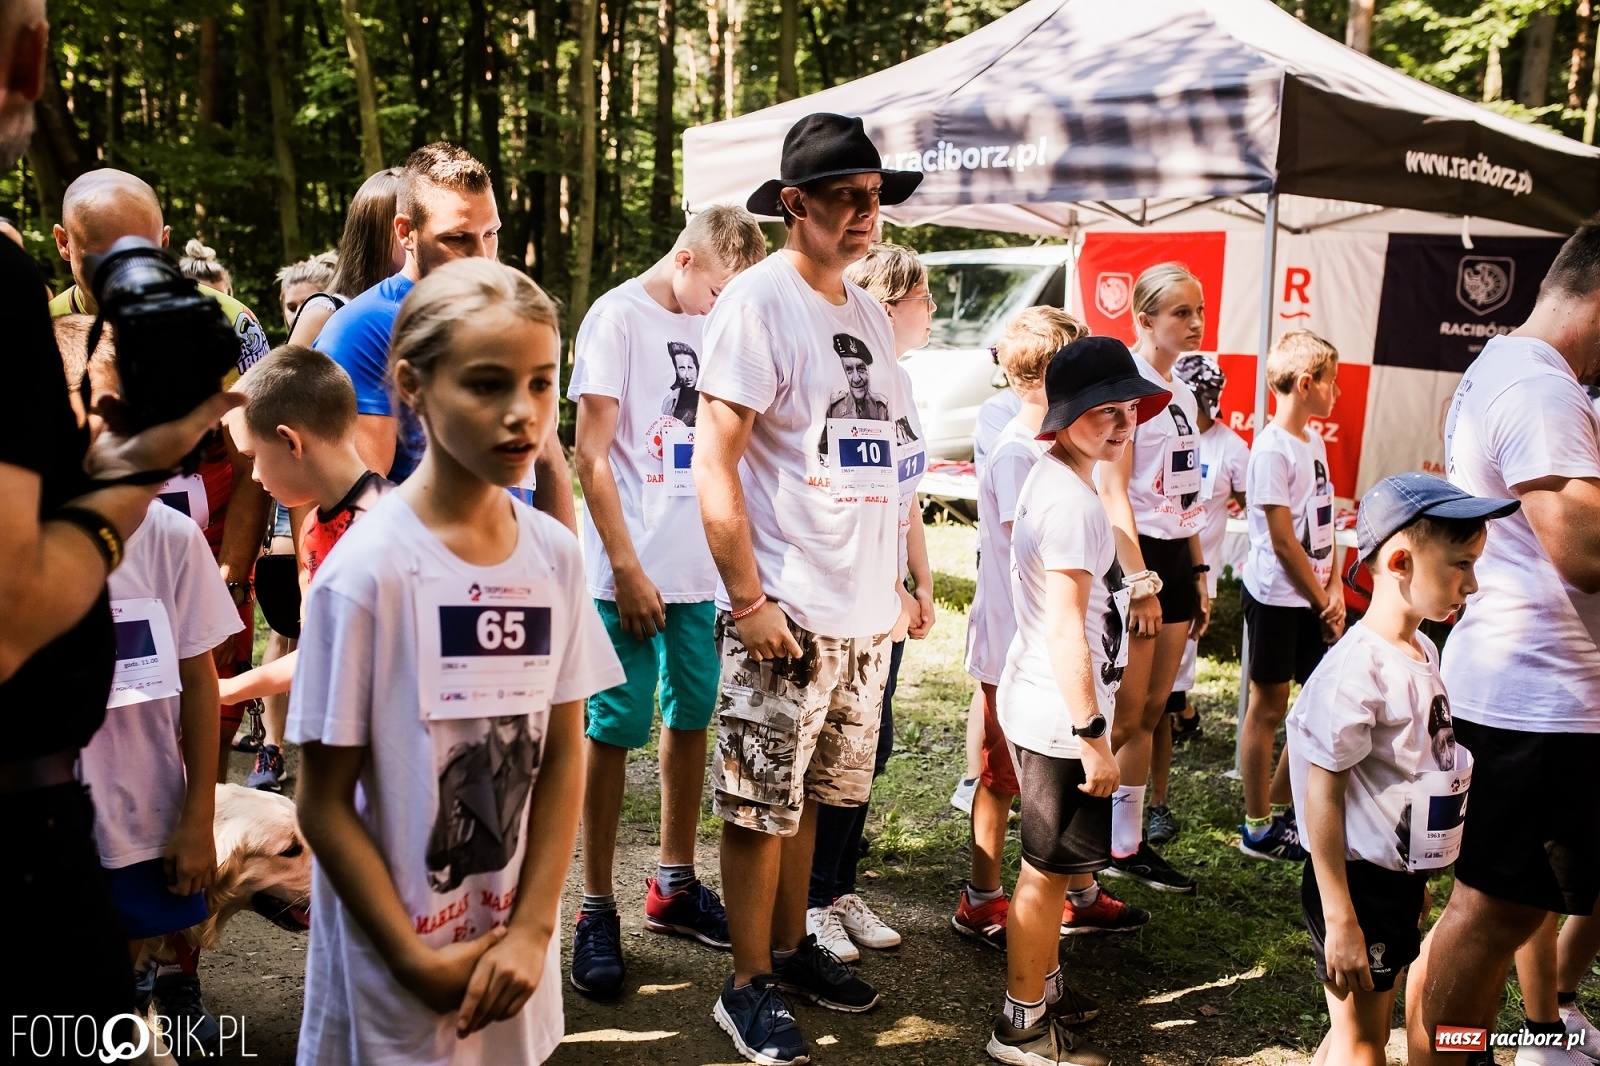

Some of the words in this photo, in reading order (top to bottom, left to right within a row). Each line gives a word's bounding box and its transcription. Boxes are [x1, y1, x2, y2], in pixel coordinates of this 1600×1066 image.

[1405, 150, 1533, 196] www.raciborz.pl
[1284, 267, 1311, 304] R
[857, 441, 881, 463] 10
[1187, 451, 1194, 468] 8
[906, 456, 917, 477] 11
[646, 474, 664, 483] DAN
[808, 476, 830, 489] MAR
[476, 610, 526, 650] 65
